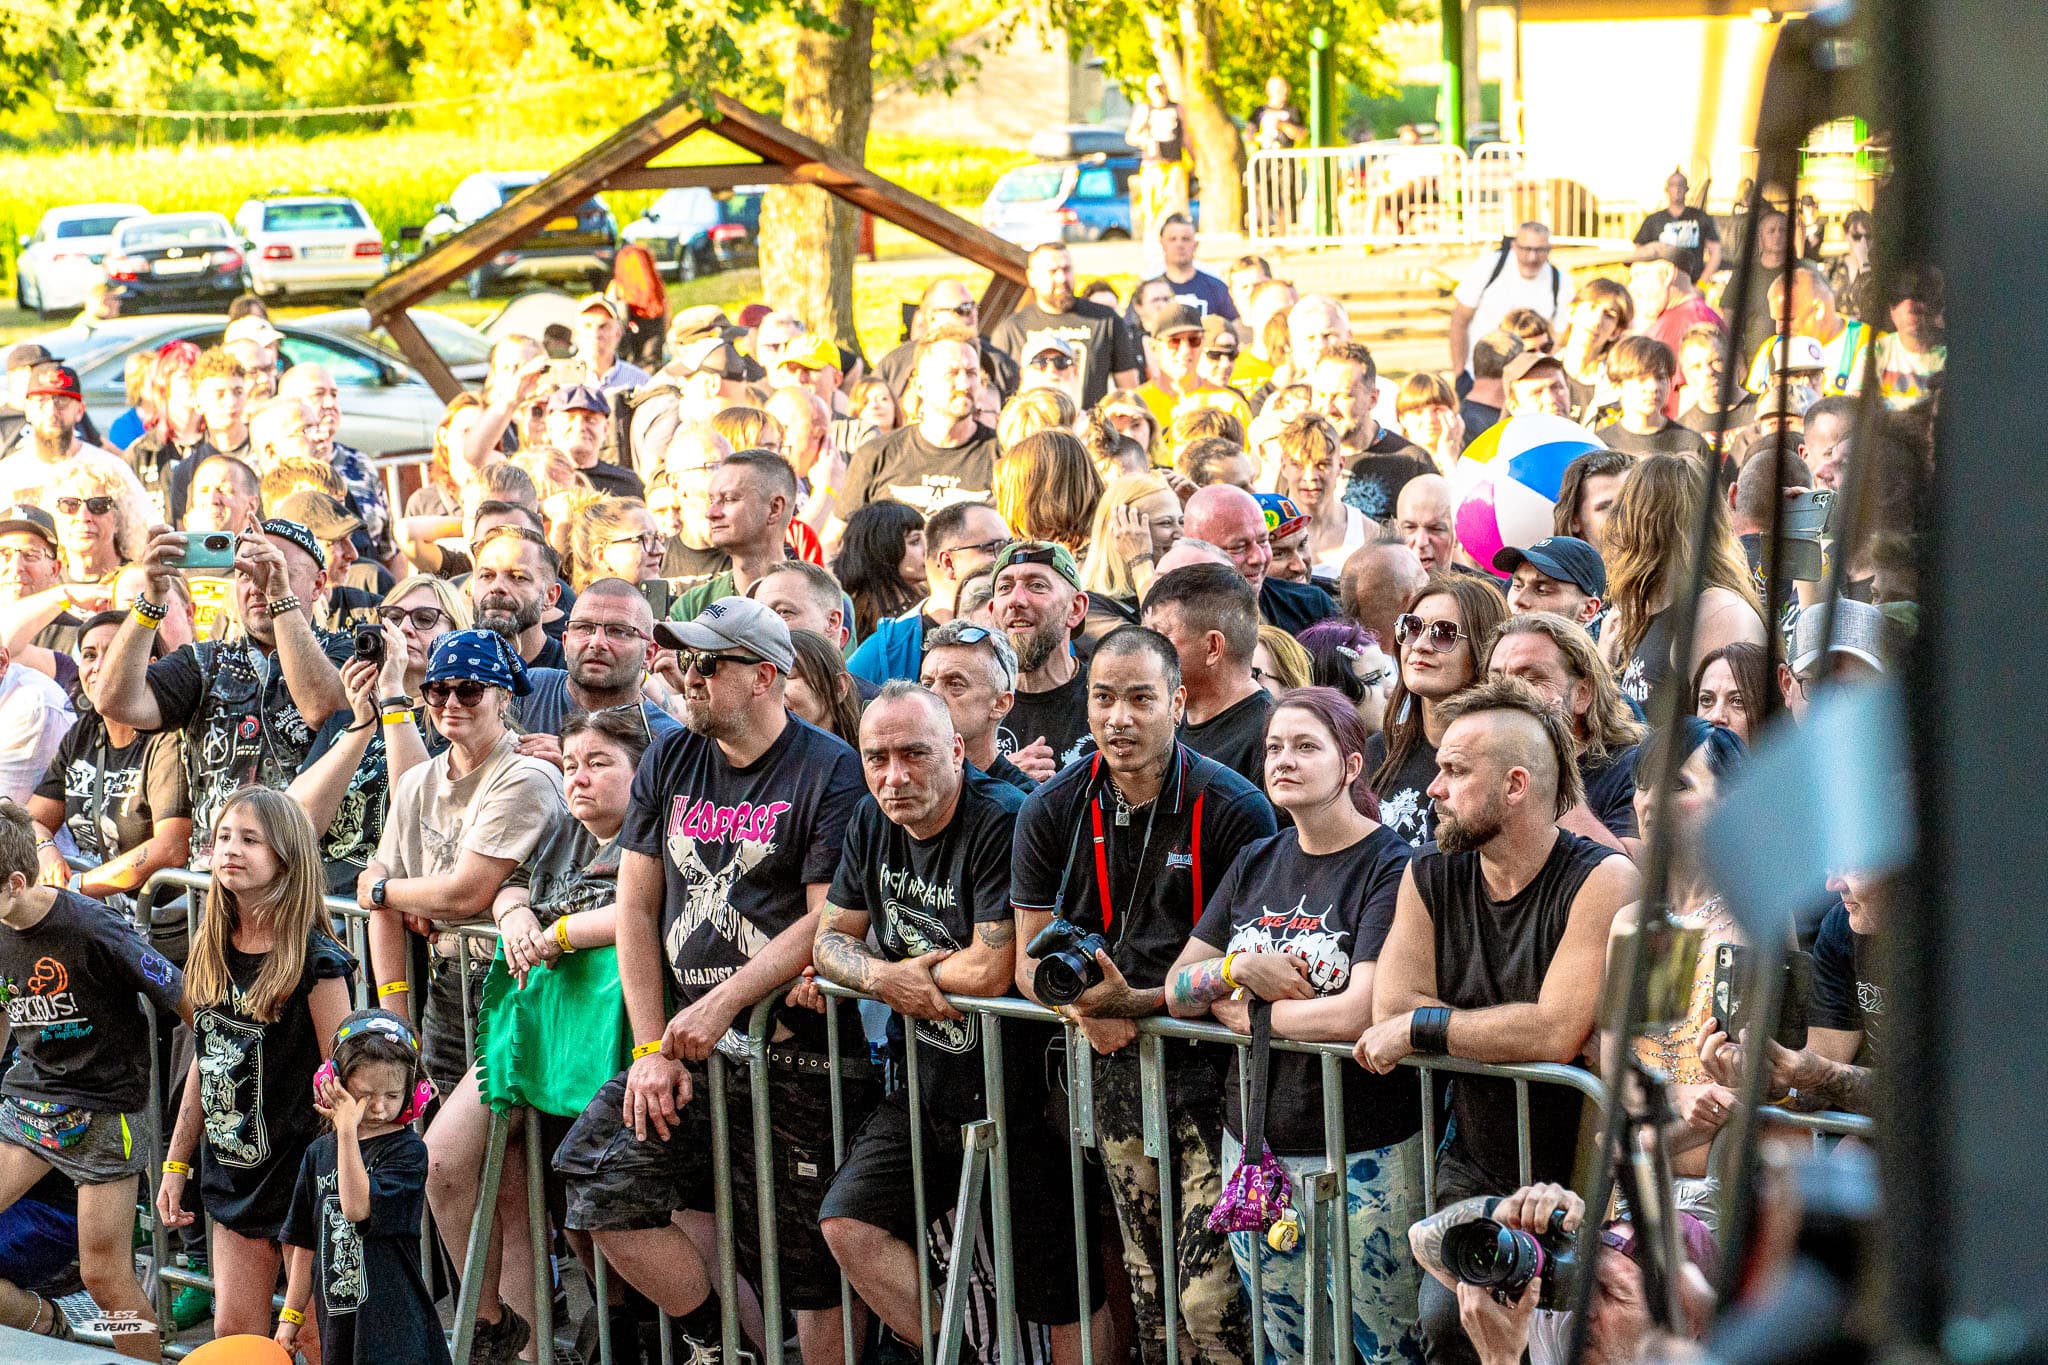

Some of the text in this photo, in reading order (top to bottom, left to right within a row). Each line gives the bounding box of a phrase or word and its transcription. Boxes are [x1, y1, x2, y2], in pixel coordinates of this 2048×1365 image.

[265, 522, 293, 536] SMILE
[682, 797, 792, 845] CORPSE
[1258, 916, 1322, 930] WE ARE
[684, 966, 733, 985] AGAINST
[316, 1167, 338, 1197] ROCK
